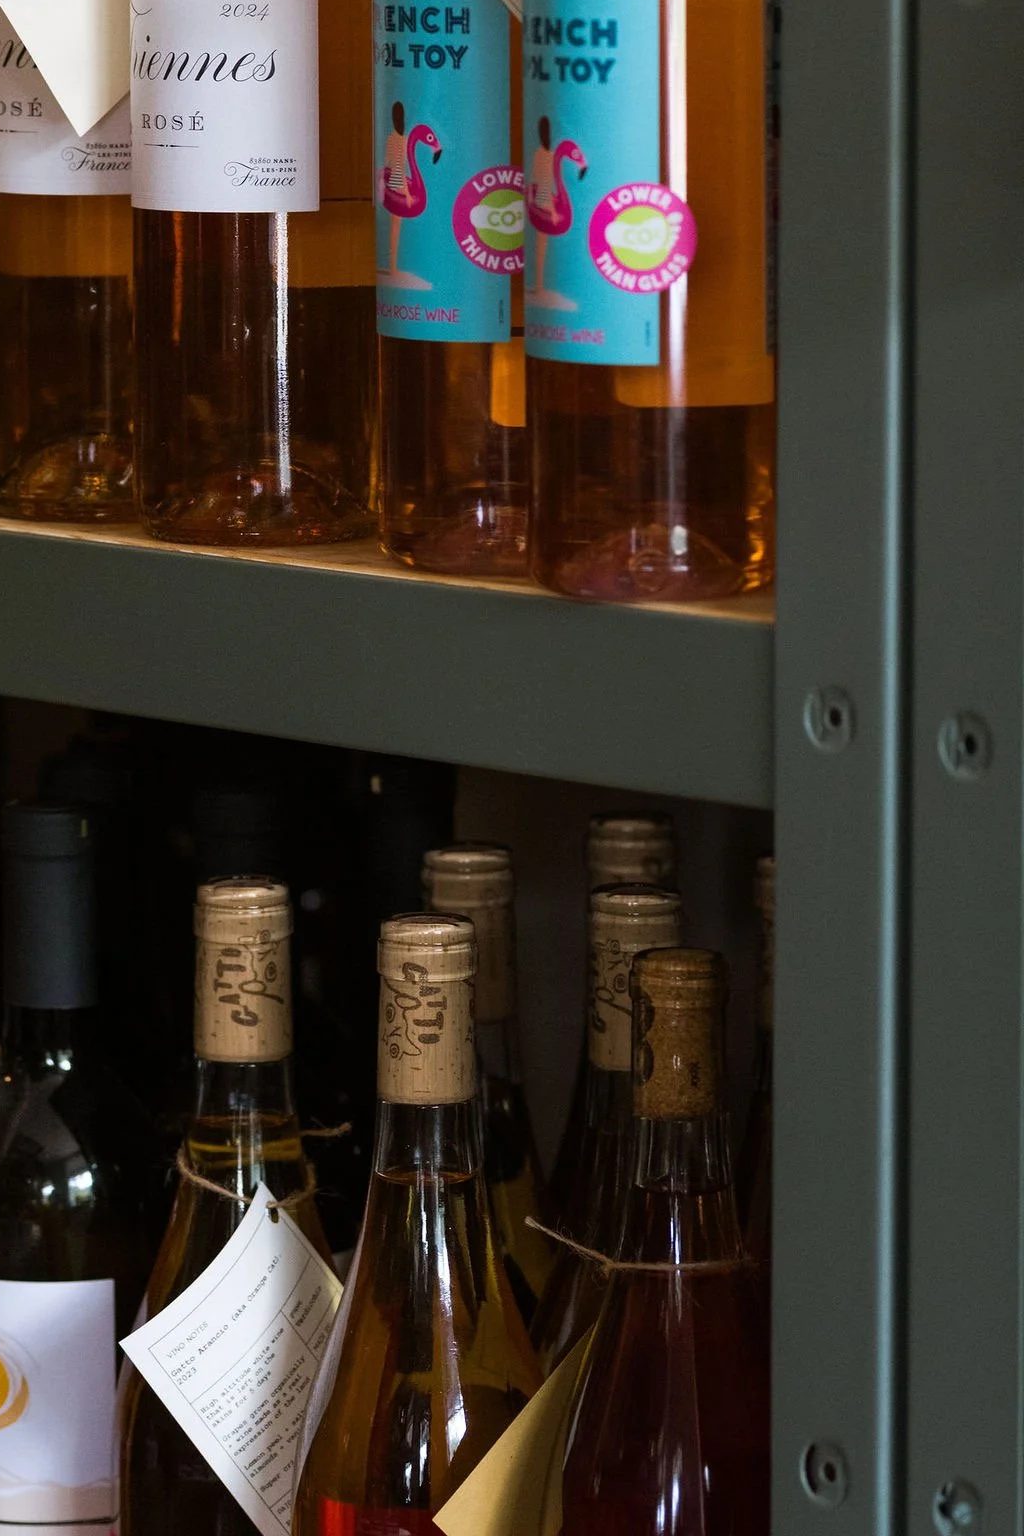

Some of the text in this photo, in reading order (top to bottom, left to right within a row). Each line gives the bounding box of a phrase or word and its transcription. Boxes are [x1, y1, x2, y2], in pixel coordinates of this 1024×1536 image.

[219, 3, 270, 21] 2024
[408, 44, 469, 69] TOY
[554, 57, 617, 84] TOY
[141, 111, 205, 131] ROSÉ
[224, 161, 297, 187] France
[607, 185, 673, 212] LOWER
[460, 234, 501, 270] THAN
[596, 251, 689, 292] THAN GLASS
[393, 304, 460, 323] ROSÉ WINE
[213, 947, 259, 1027] GATTO
[402, 961, 448, 1044] GATTO
[166, 1321, 209, 1359] VINO NOTES
[170, 1356, 196, 1378] Gatto
[197, 1324, 229, 1355] Arancio
[231, 1304, 247, 1321] (aka
[247, 1275, 268, 1302] Orange
[176, 1366, 198, 1386] 2023
[200, 1327, 285, 1414] High altitude white wine
[206, 1405, 224, 1421] that
[237, 1377, 253, 1394] left
[255, 1366, 264, 1377] on
[264, 1352, 276, 1365] the
[212, 1410, 234, 1428] skins
[235, 1395, 249, 1408] for
[257, 1370, 272, 1388] days
[222, 1355, 306, 1443] Grapes grown organically
[233, 1420, 274, 1457] expression
[236, 1426, 253, 1442] wine
[254, 1409, 272, 1426] made
[244, 1451, 266, 1471] Lemon
[266, 1434, 283, 1452] peel
[249, 1452, 279, 1478] almonds
[259, 1473, 282, 1493] Super
